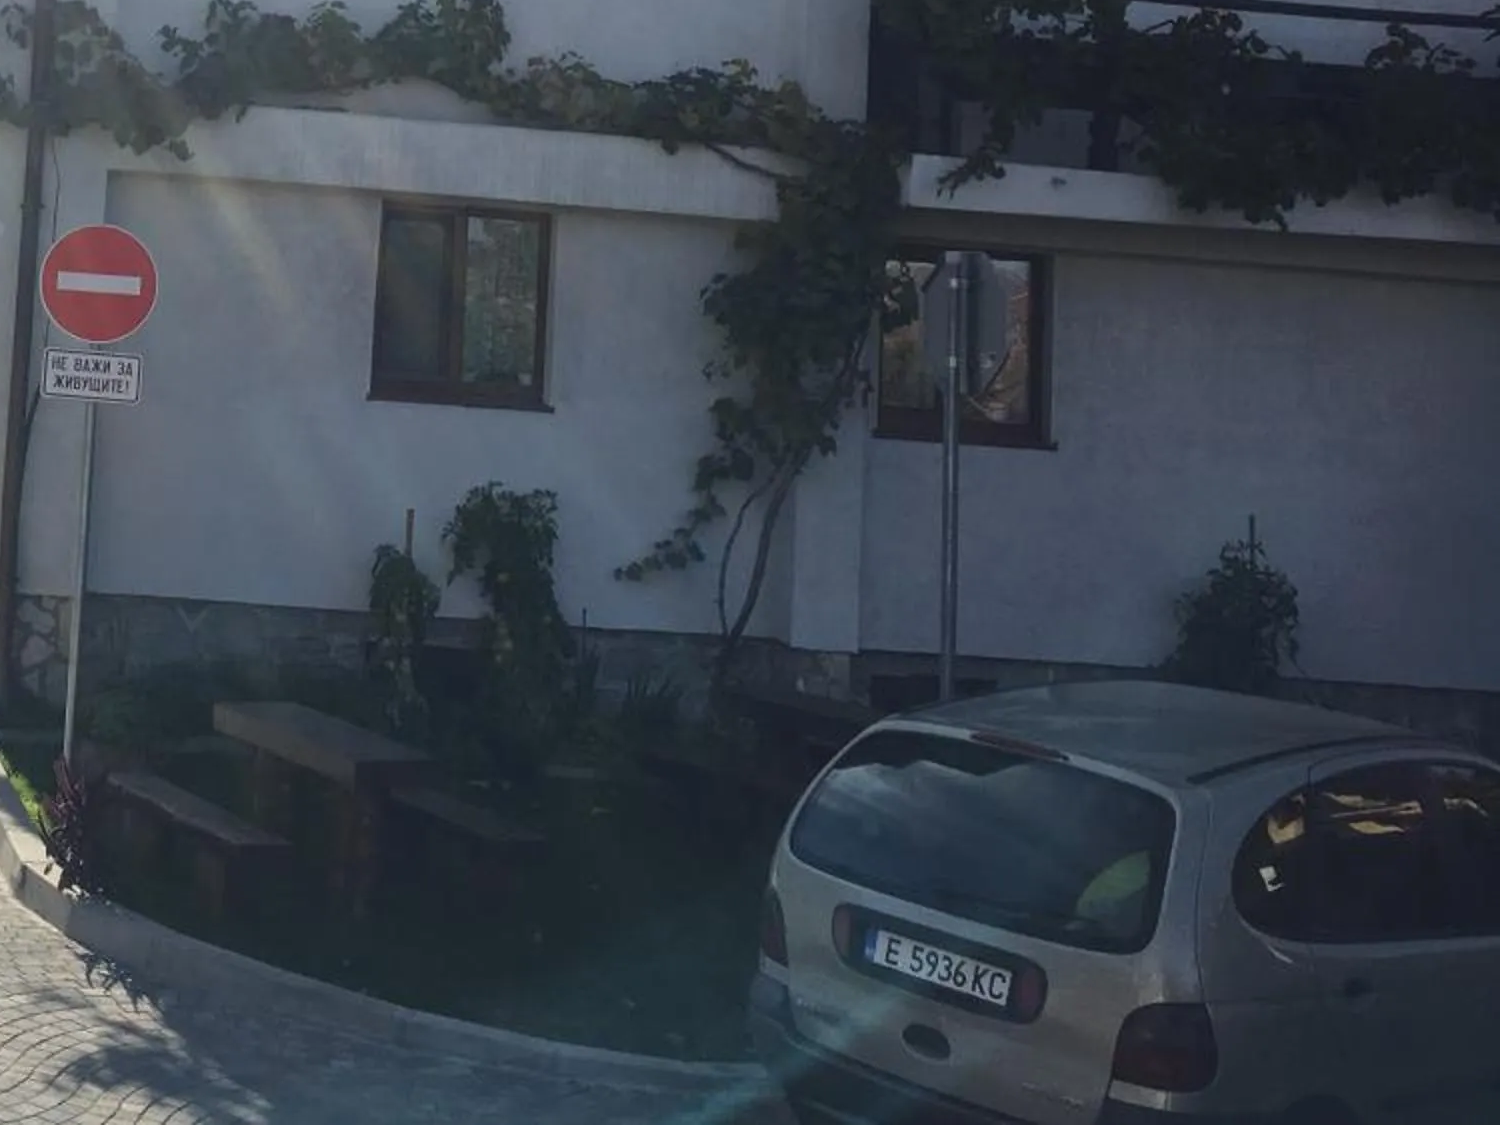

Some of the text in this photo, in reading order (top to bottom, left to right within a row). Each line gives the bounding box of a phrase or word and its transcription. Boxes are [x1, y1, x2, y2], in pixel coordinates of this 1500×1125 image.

[51, 356, 133, 376] НЕ ВАЖИ ЗА
[53, 374, 130, 394] ЖИВУЩИТЕ!
[884, 938, 901, 966] E
[909, 944, 967, 988] 5936
